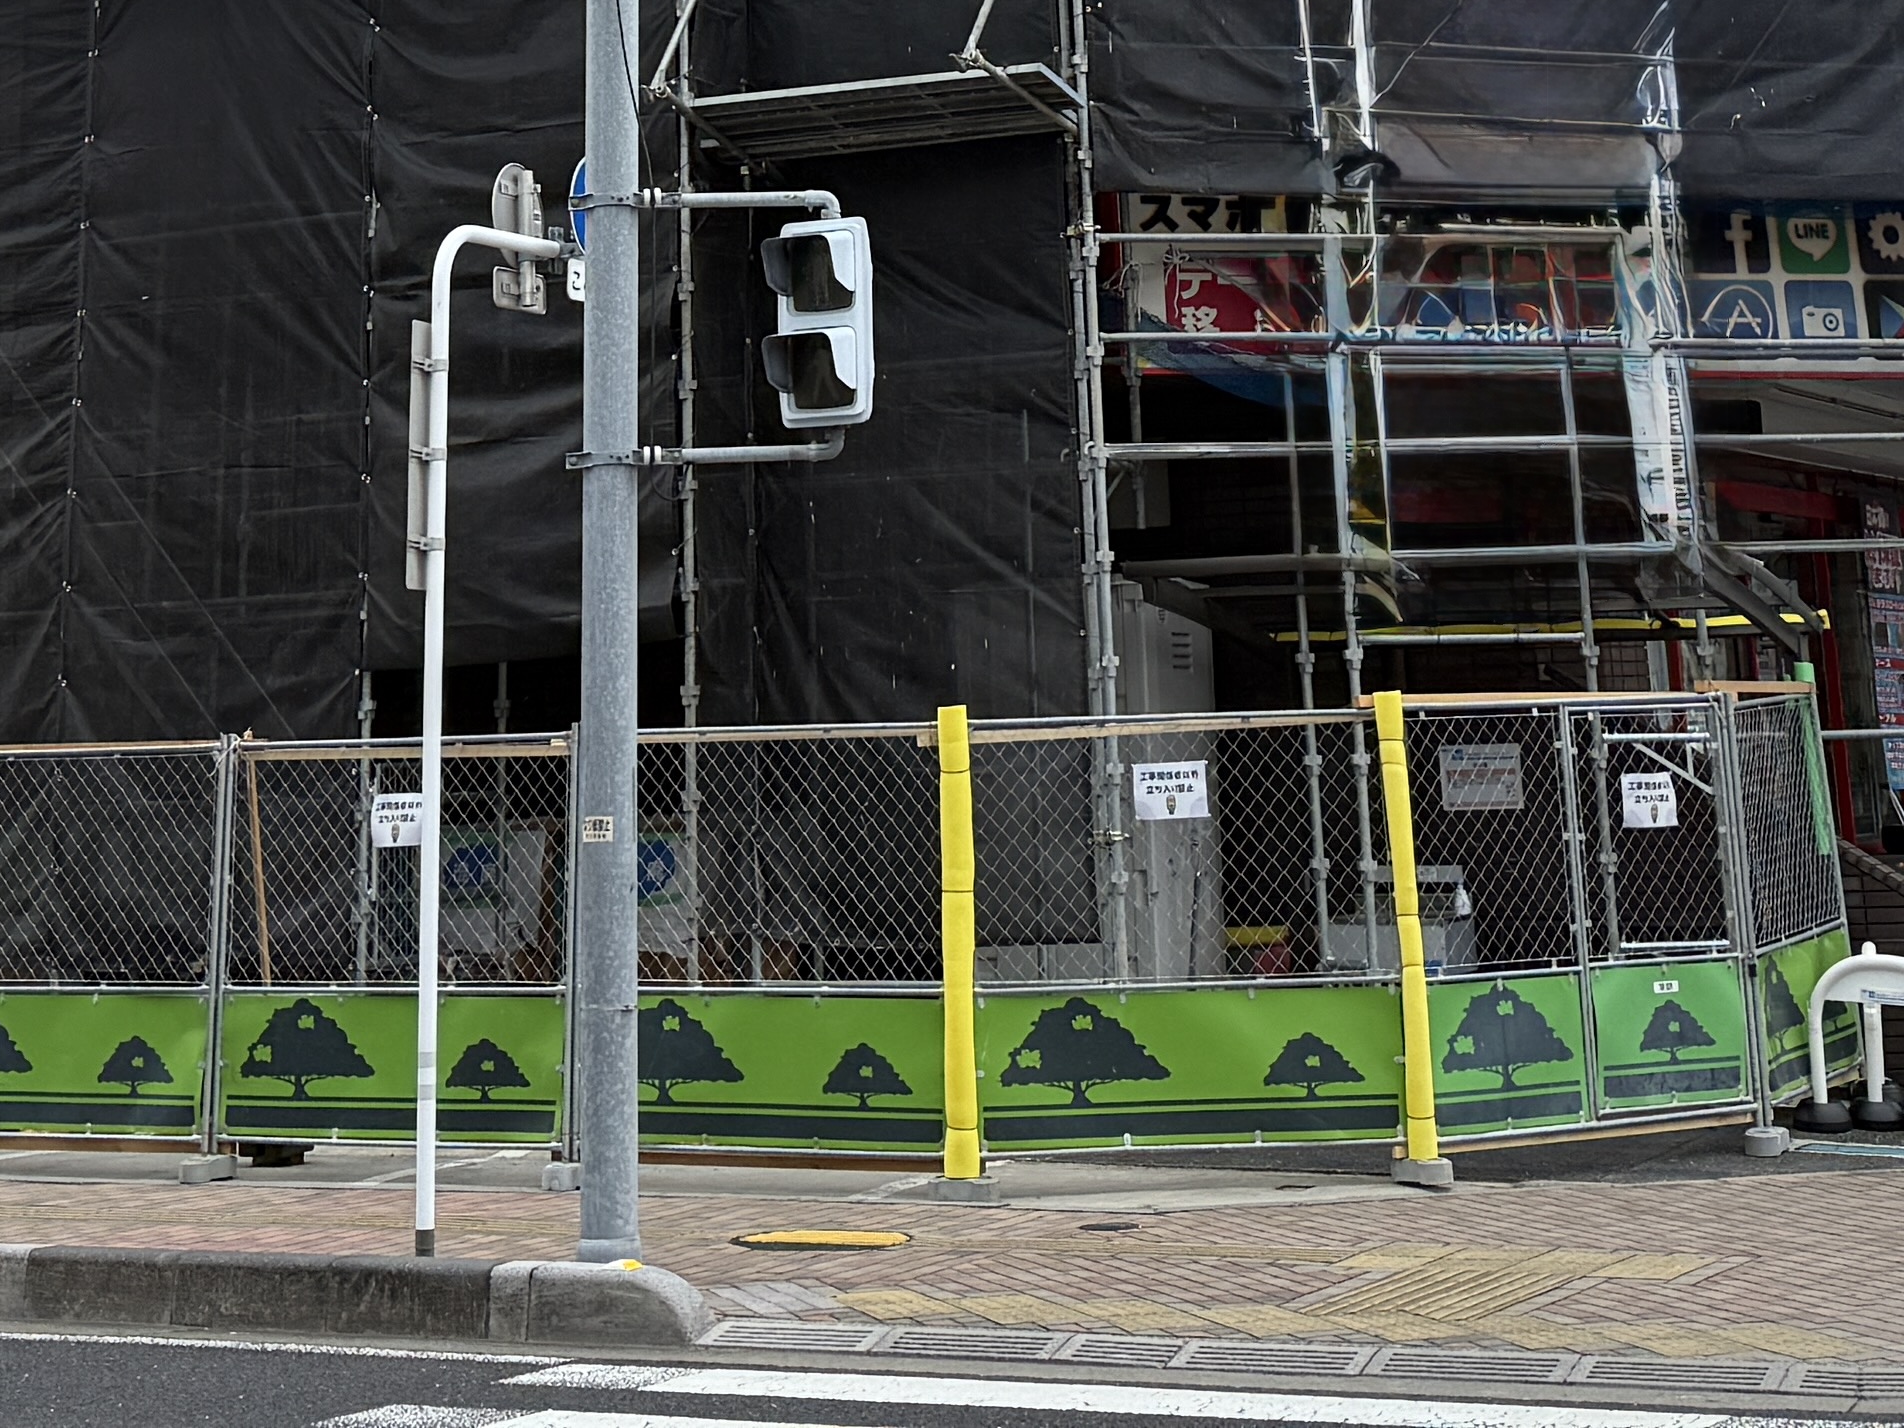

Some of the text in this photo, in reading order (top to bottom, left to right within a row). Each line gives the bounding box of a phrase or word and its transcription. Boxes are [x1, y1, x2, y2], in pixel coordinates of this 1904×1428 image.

[1139, 195, 1276, 233] スマホ
[1794, 222, 1831, 241] LINE
